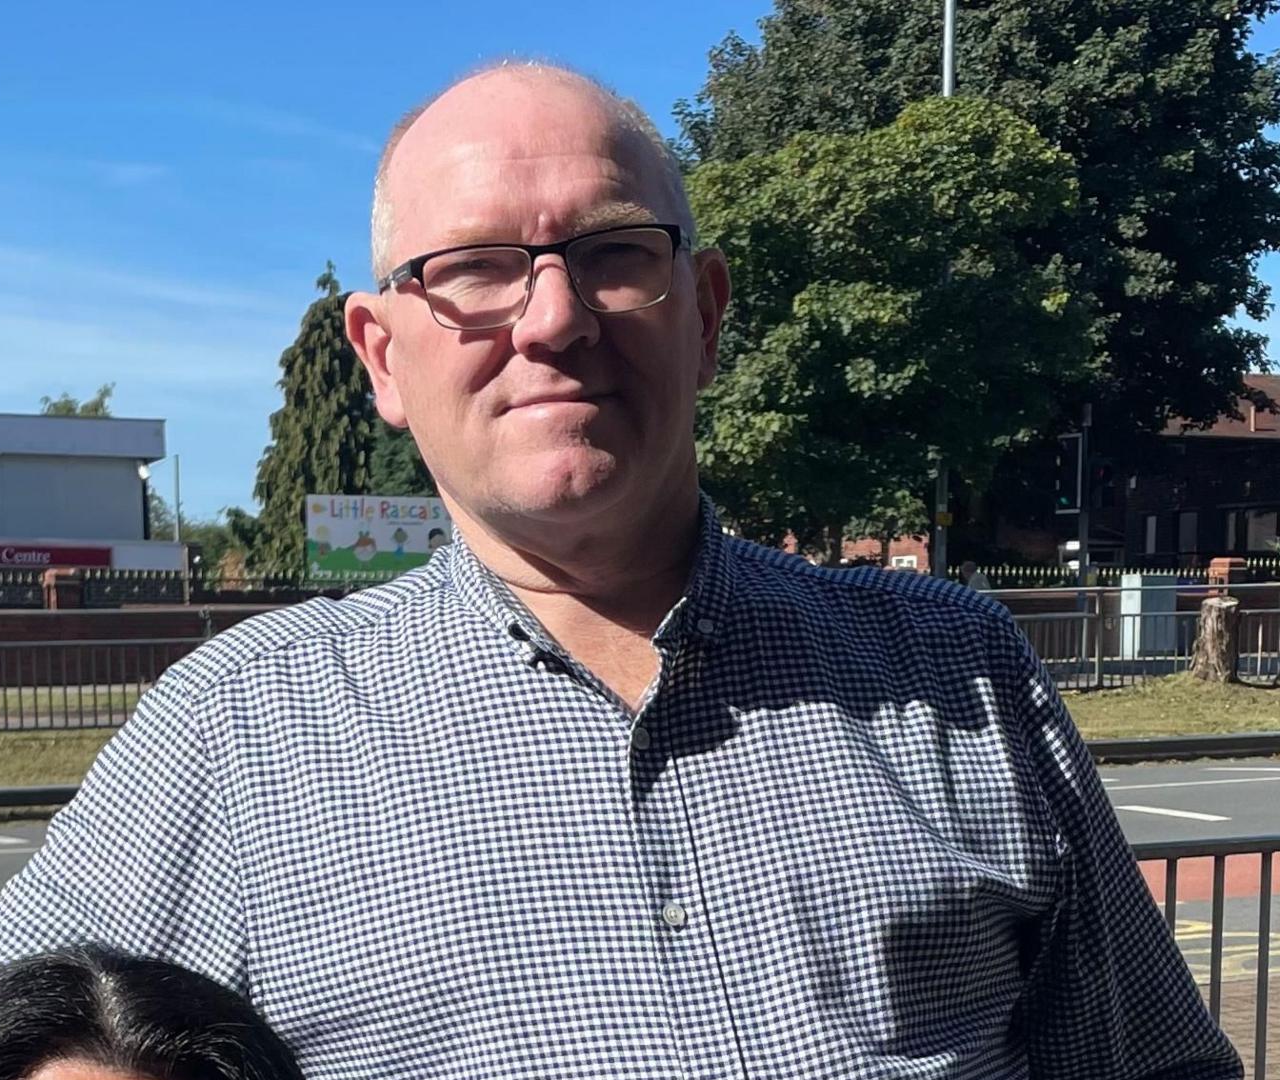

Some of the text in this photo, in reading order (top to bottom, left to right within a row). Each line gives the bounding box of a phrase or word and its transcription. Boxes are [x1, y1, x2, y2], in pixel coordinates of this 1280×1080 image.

[330, 498, 374, 520] Little
[380, 500, 441, 520] Rascals
[2, 548, 51, 564] Centre
